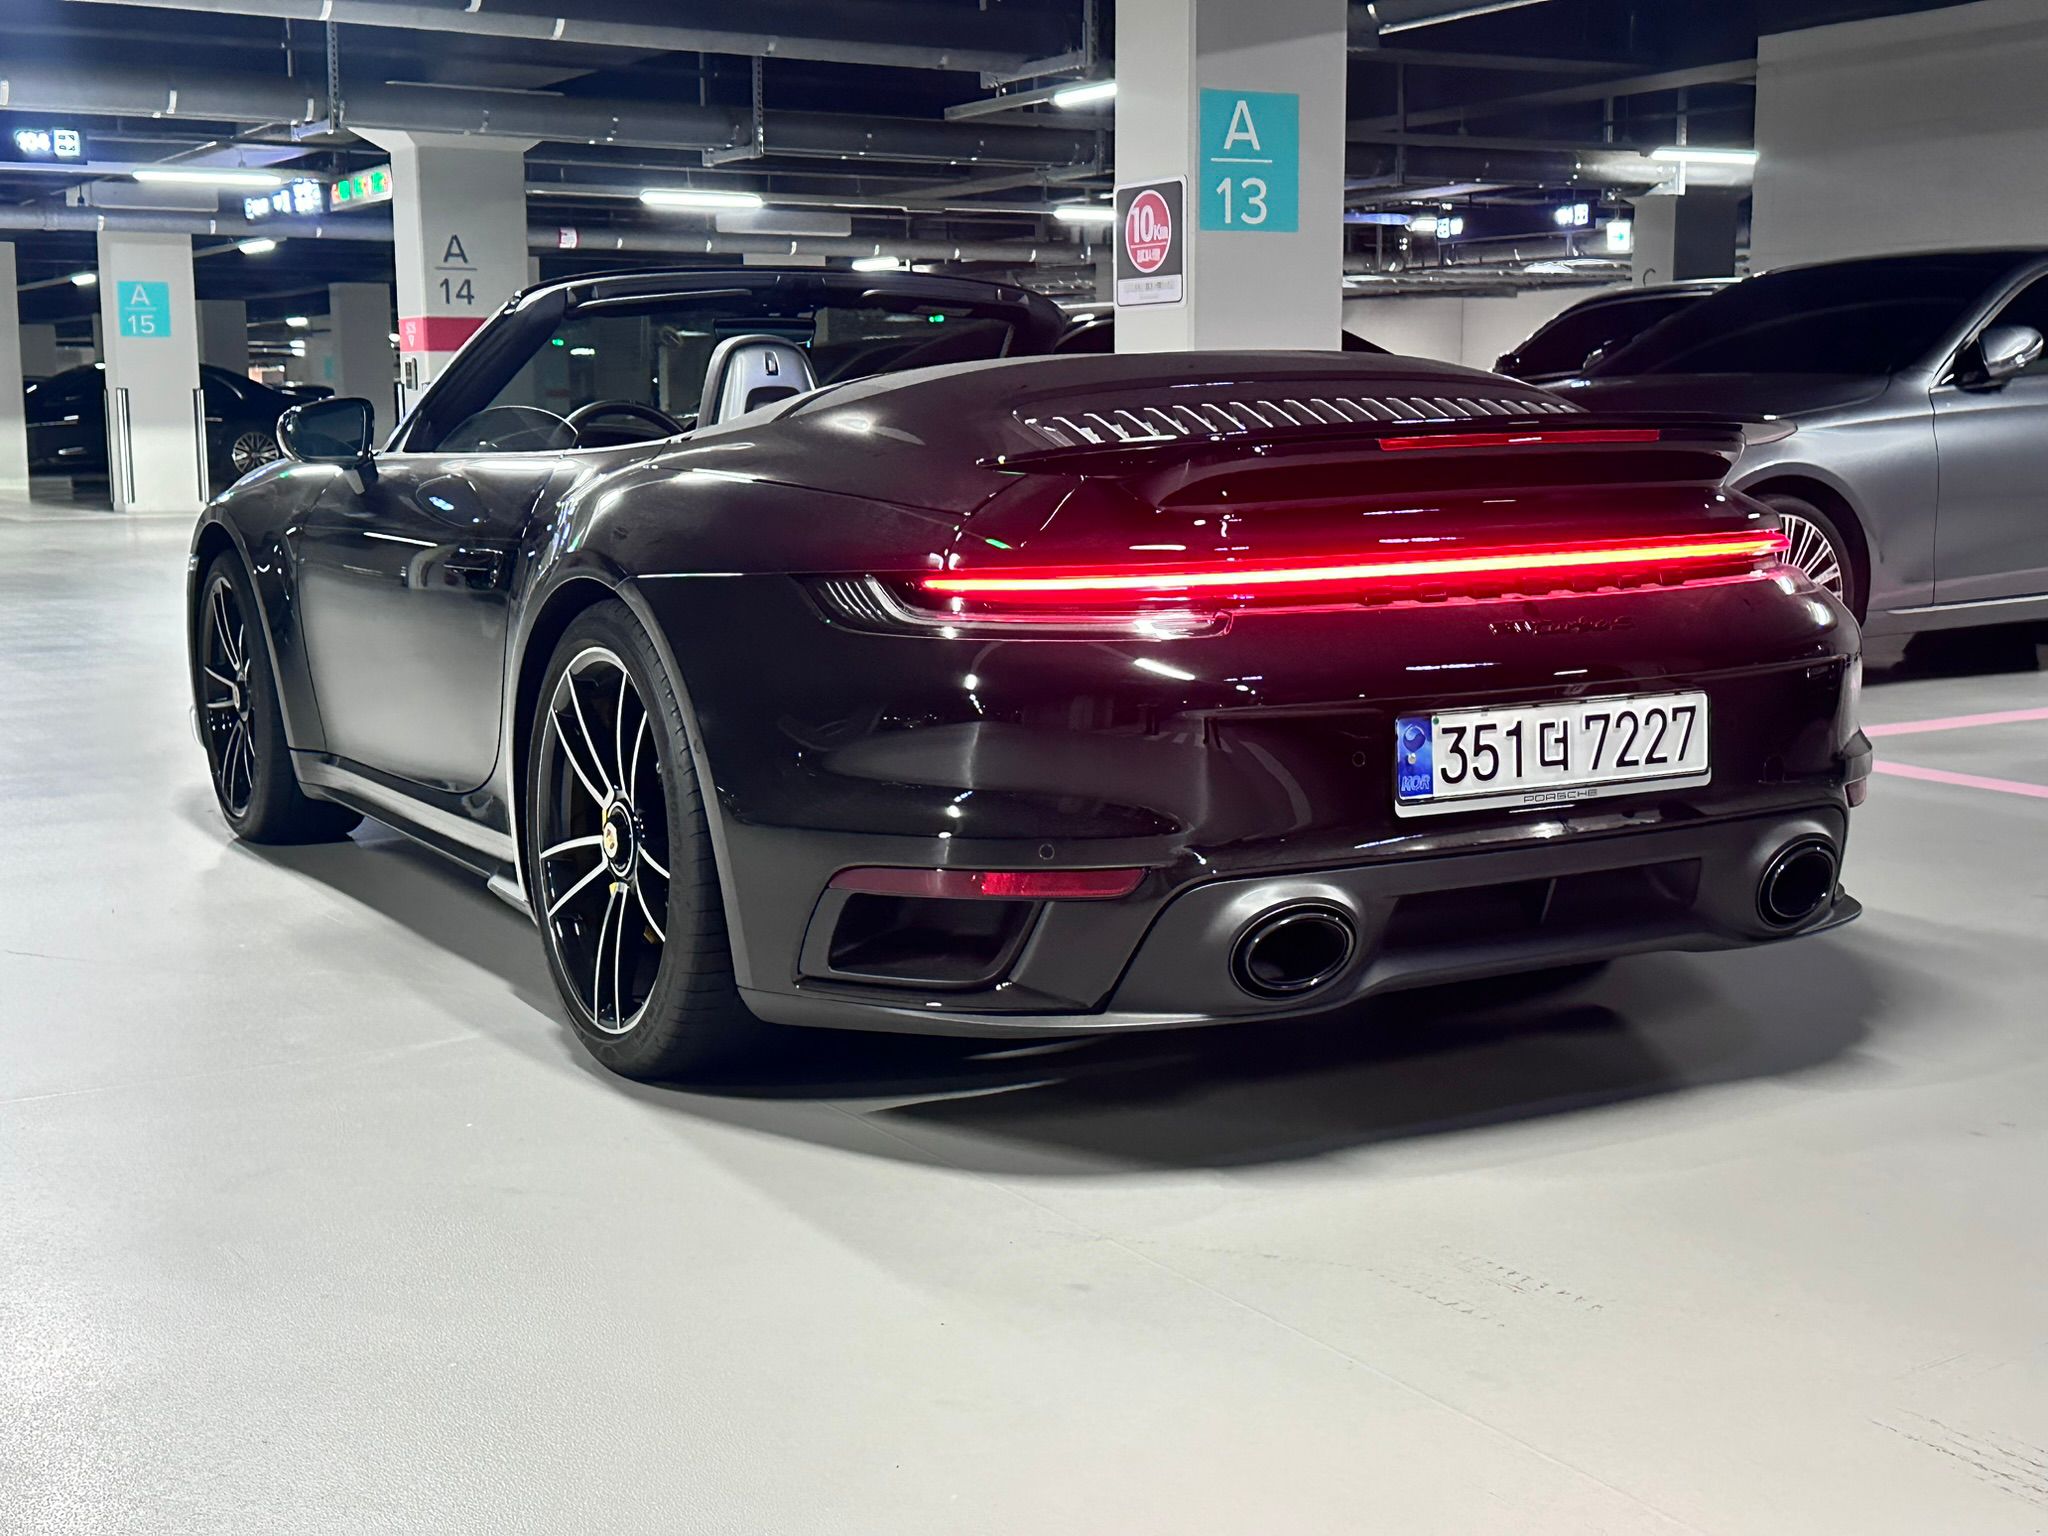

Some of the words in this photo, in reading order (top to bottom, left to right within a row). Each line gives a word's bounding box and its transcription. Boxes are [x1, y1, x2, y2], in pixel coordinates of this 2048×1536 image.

[1223, 99, 1261, 151] A
[1216, 176, 1267, 225] 13
[443, 234, 468, 264] A
[130, 284, 151, 306] A
[440, 278, 475, 305] 14
[127, 314, 155, 334] 15
[1585, 706, 1697, 771] 7227
[1523, 789, 1598, 804] PORSCHE
